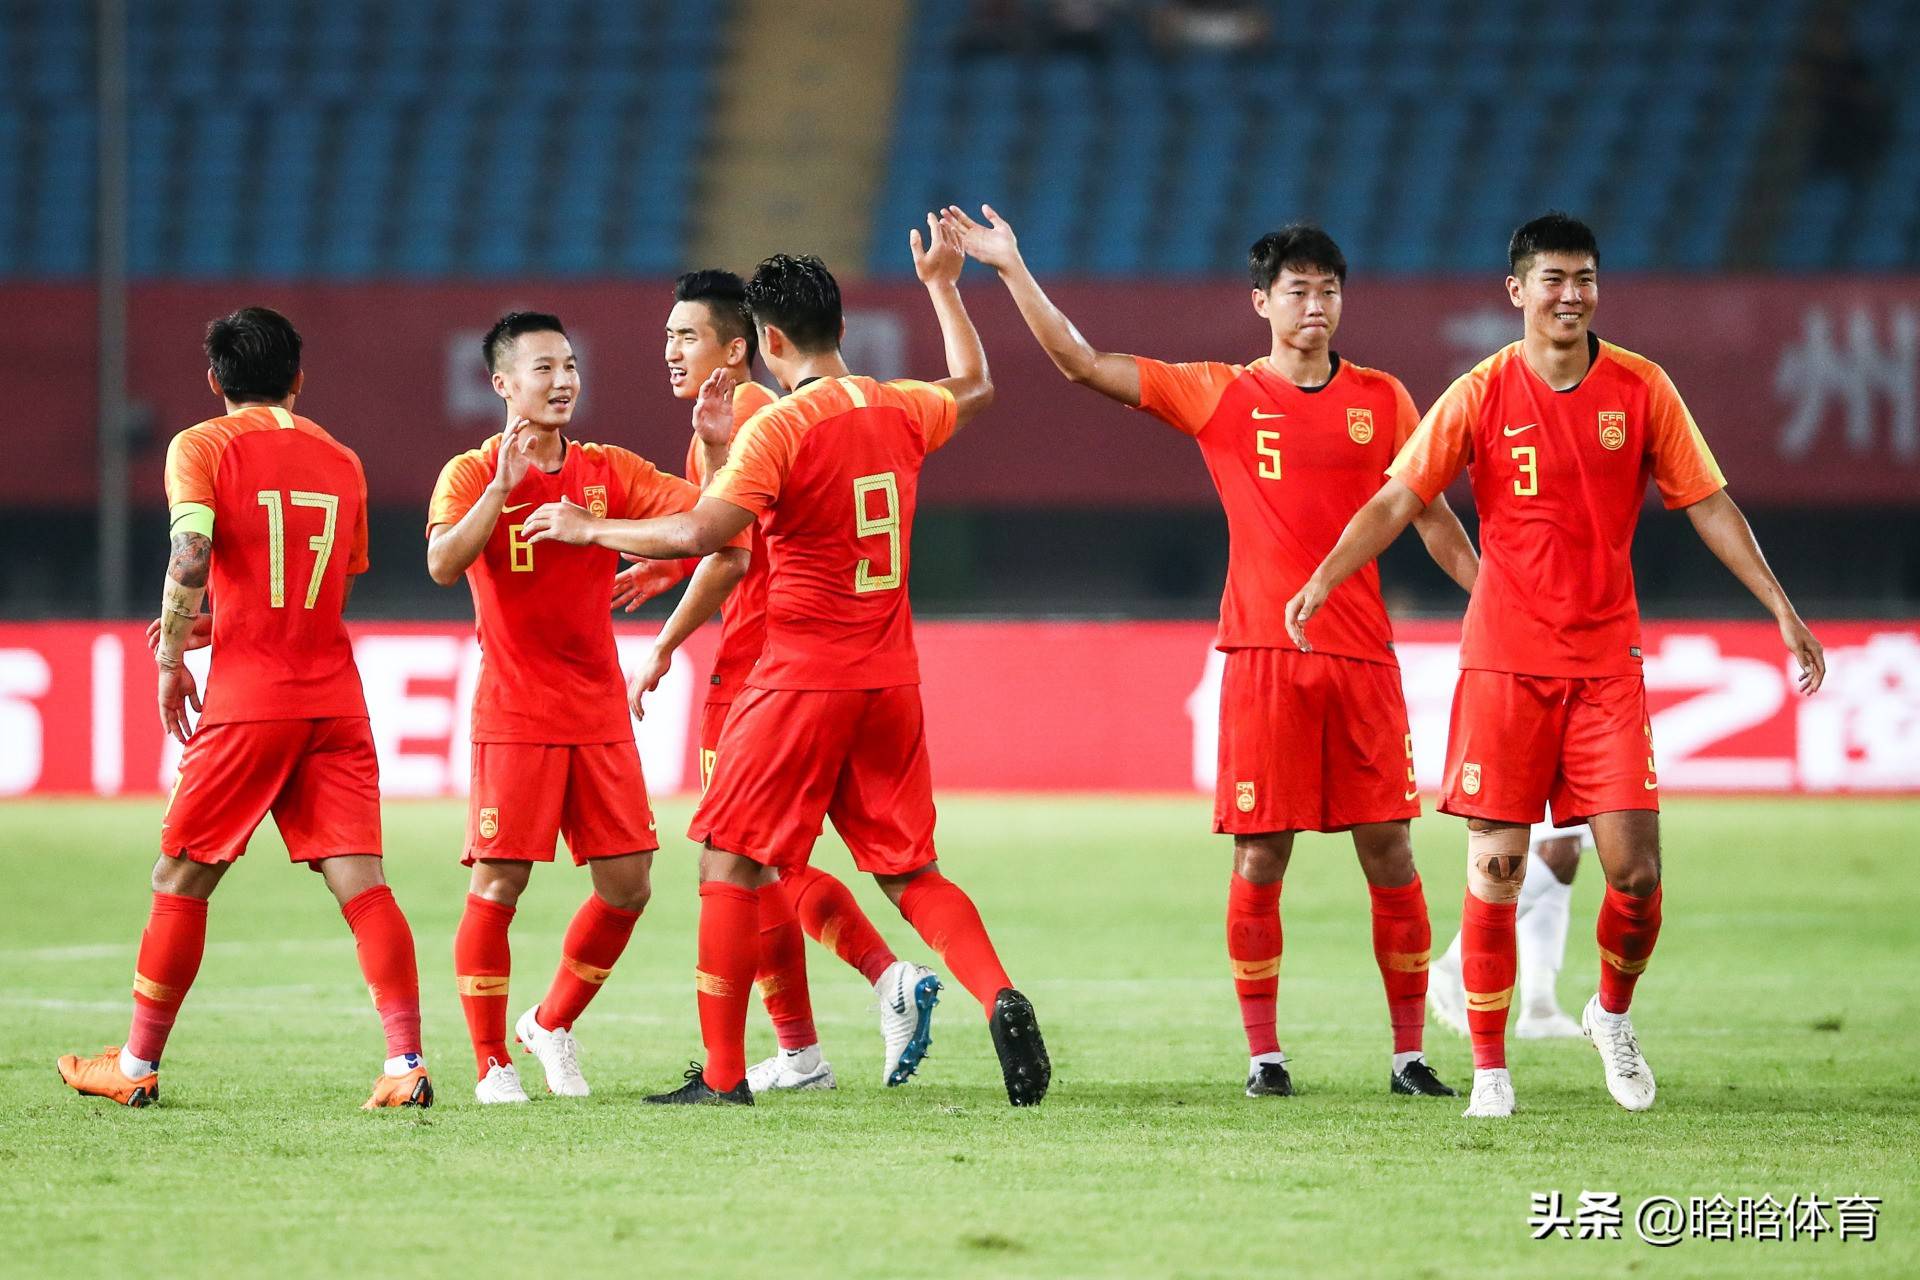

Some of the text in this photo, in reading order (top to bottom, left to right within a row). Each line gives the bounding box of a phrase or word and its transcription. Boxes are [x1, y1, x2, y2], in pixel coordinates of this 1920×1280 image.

[1601, 414, 1624, 422] CFA
[1257, 430, 1281, 480] 5
[1511, 446, 1538, 496] 3
[257, 490, 339, 609] 17
[509, 524, 533, 572] 6
[853, 471, 901, 593] 9
